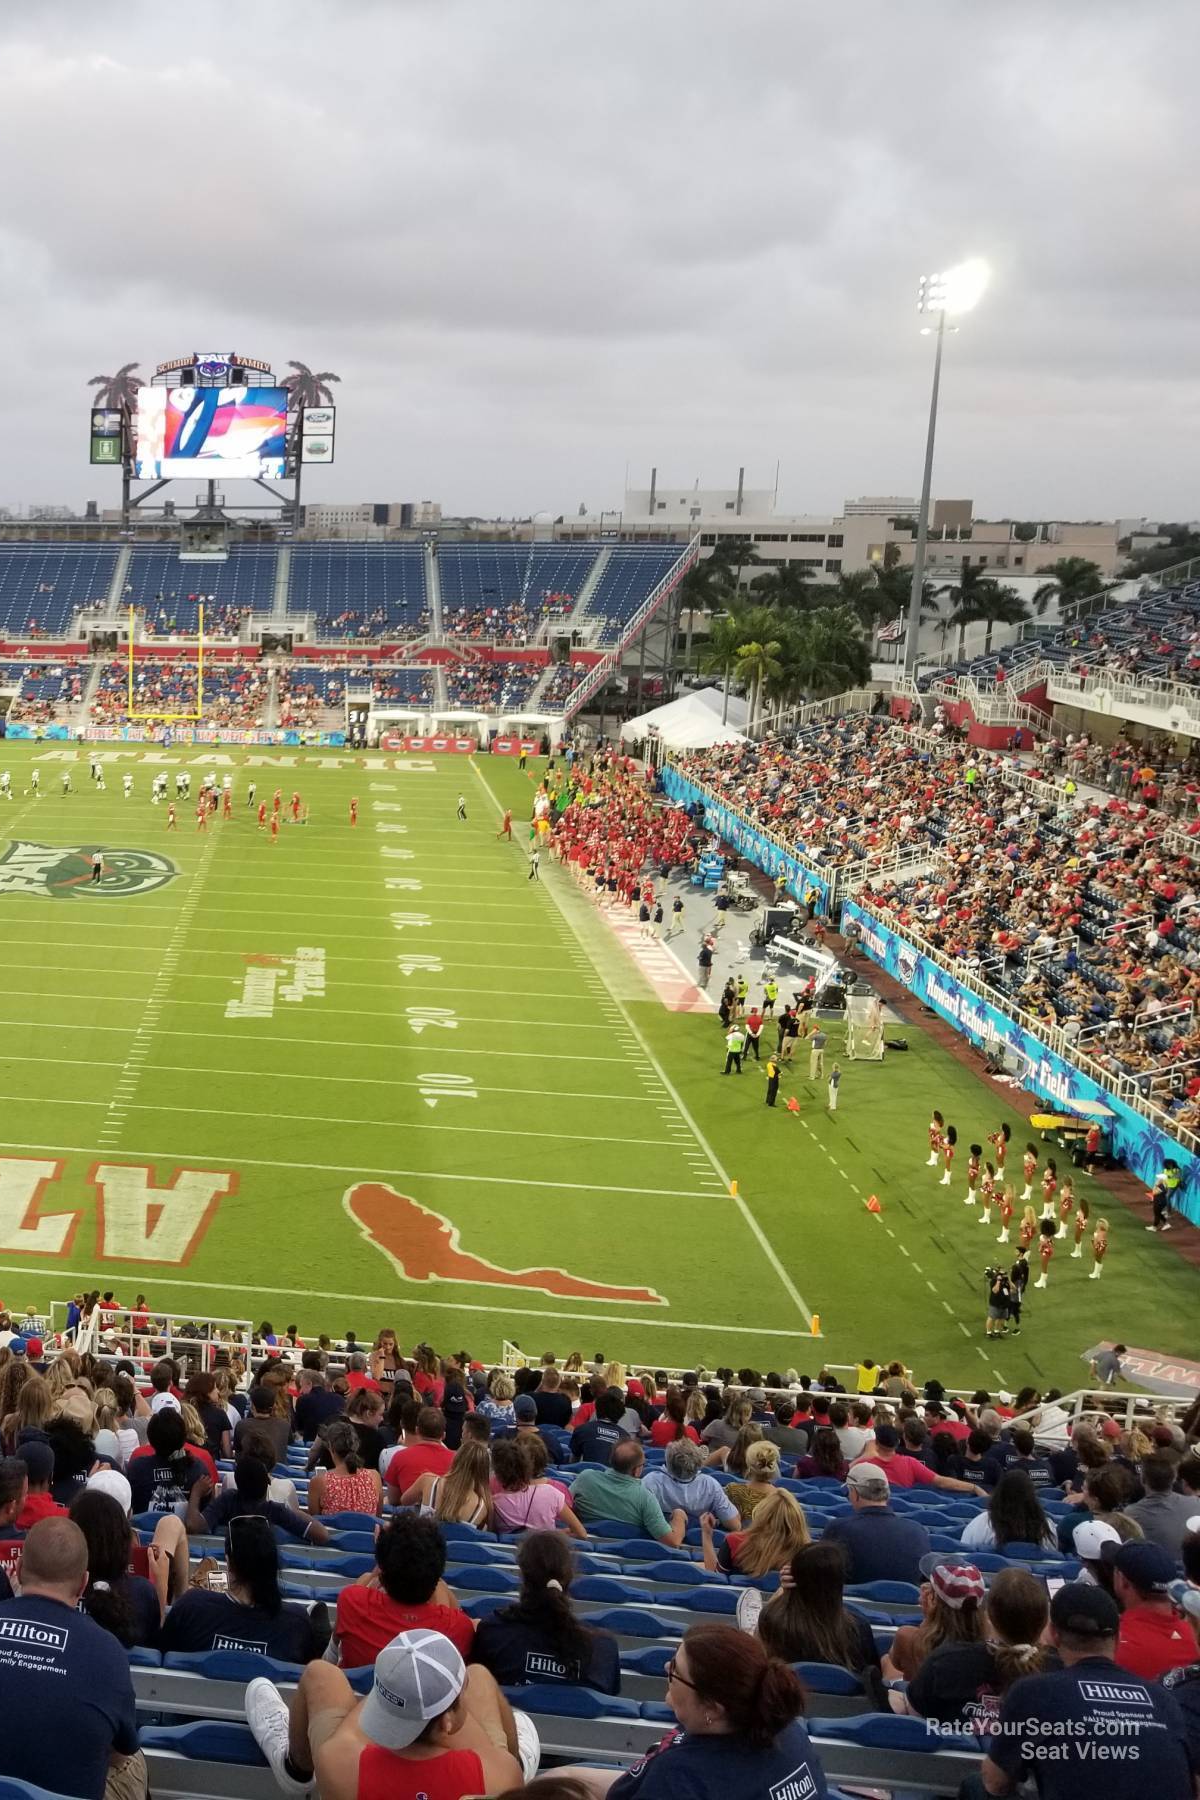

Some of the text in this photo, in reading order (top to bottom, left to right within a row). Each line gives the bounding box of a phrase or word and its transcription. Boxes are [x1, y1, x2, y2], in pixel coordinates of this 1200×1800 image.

[156, 353, 271, 373] SCHMIDT FAU FAMILY
[31, 749, 438, 771] ATLANTIC
[397, 954, 443, 972] 30
[405, 1006, 459, 1029] 20
[926, 973, 960, 1016] Howard
[1039, 1060, 1069, 1100] Field
[416, 1073, 478, 1098] 10
[0, 1621, 60, 1645] Hilton
[13, 1651, 45, 1663] Sponsor
[46, 1656, 55, 1664] of
[17, 1659, 67, 1676] Engagement
[530, 1656, 567, 1674] Hilto
[1085, 1683, 1145, 1702] Hilton
[1093, 1709, 1116, 1717] Proud
[1116, 1711, 1145, 1719] Sponsor
[776, 1774, 812, 1800] Hilton
